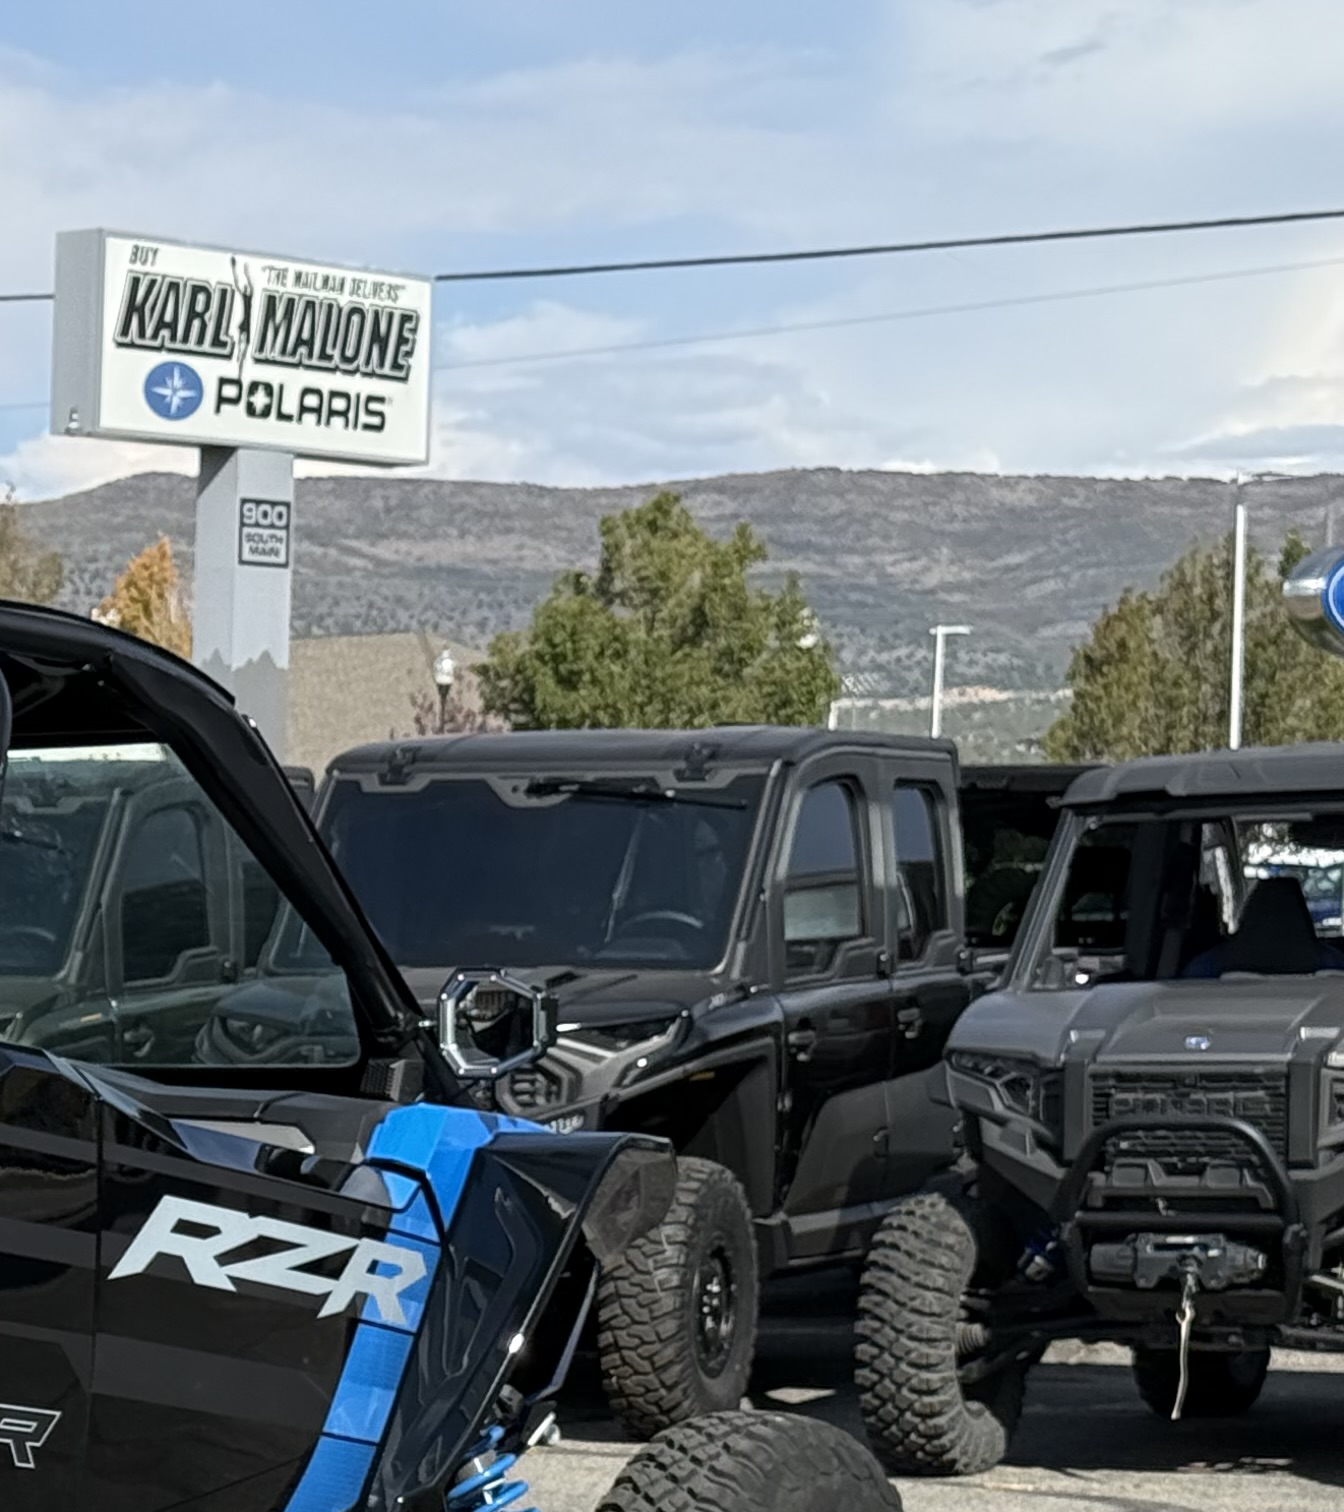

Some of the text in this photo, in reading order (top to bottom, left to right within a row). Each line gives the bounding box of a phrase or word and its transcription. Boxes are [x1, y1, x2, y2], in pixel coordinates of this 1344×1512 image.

[129, 244, 159, 267] BUY
[113, 269, 420, 384] KARL MALONE
[215, 376, 387, 433] POLARIS
[242, 502, 289, 528] 900
[108, 1194, 427, 1325] RZR
